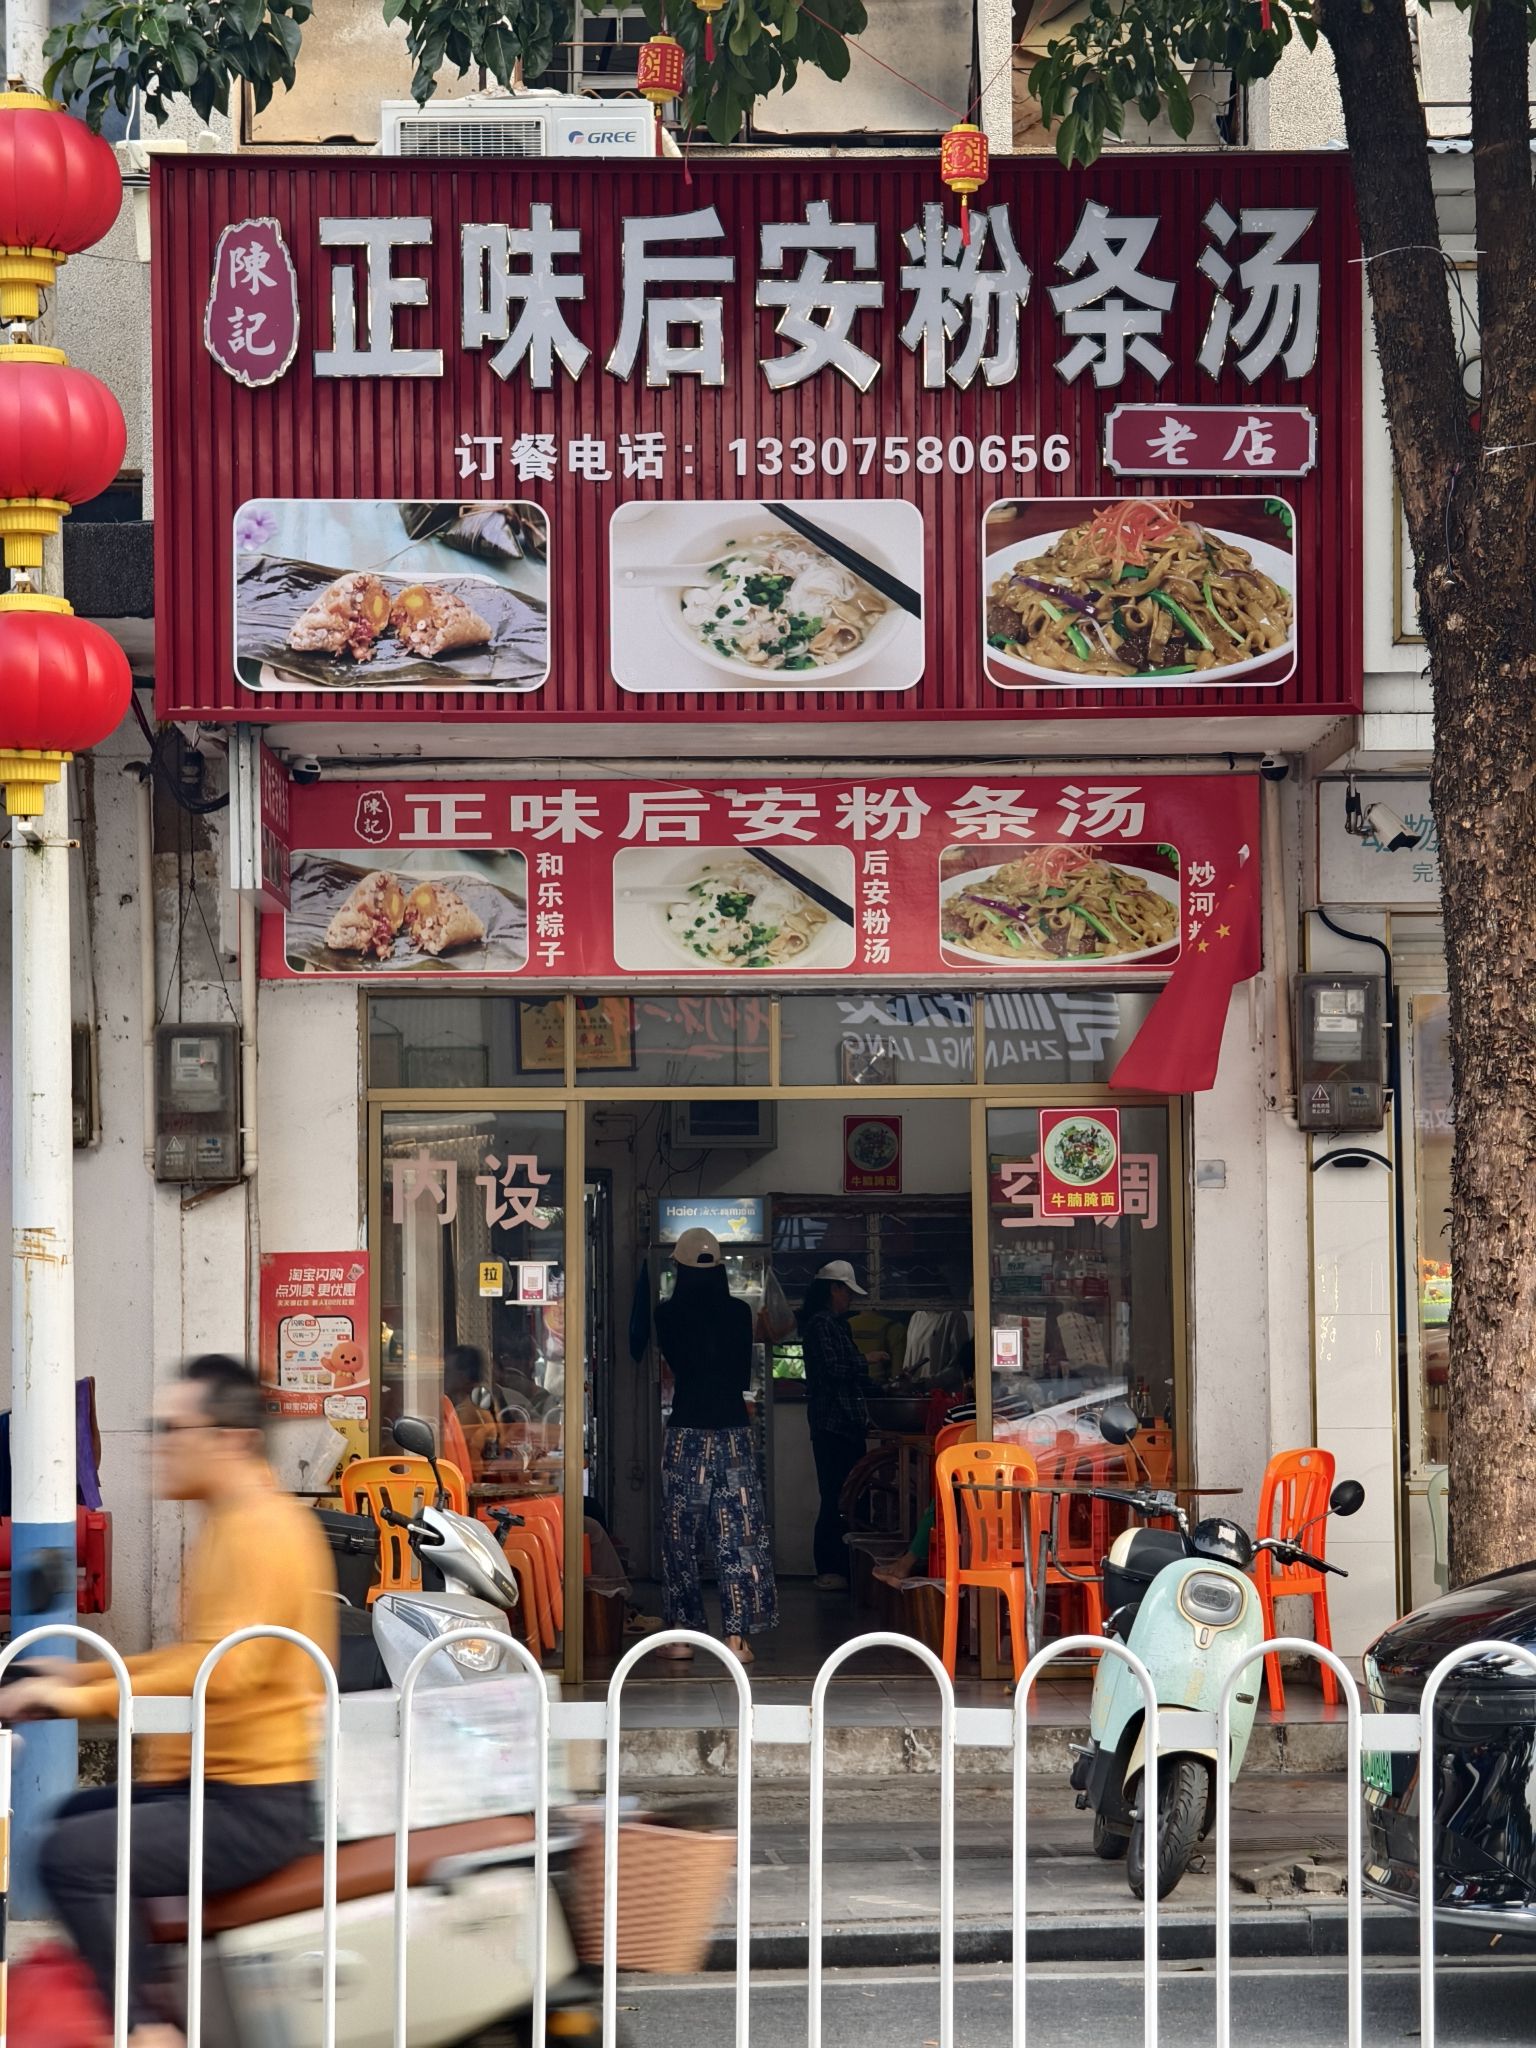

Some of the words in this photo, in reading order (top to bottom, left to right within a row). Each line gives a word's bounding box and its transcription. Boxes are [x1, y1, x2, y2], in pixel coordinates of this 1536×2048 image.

[588, 131, 637, 144] GREE
[227, 240, 278, 356] 陳記
[313, 199, 1321, 393] 正味后安粉条汤
[1146, 416, 1277, 466] 老店
[363, 798, 384, 835] 陳記
[399, 784, 1146, 843] 正味后安粉条汤
[536, 852, 565, 967] 和乐粽子
[862, 850, 891, 964] 后安粉汤
[393, 1150, 551, 1230] 内设
[666, 1206, 698, 1217] Haier
[1051, 1192, 1115, 1208] 牛腩腌面
[275, 1284, 315, 1298] 点外卖
[288, 1268, 344, 1282] 淘宝闪购
[484, 1267, 498, 1281] 拉
